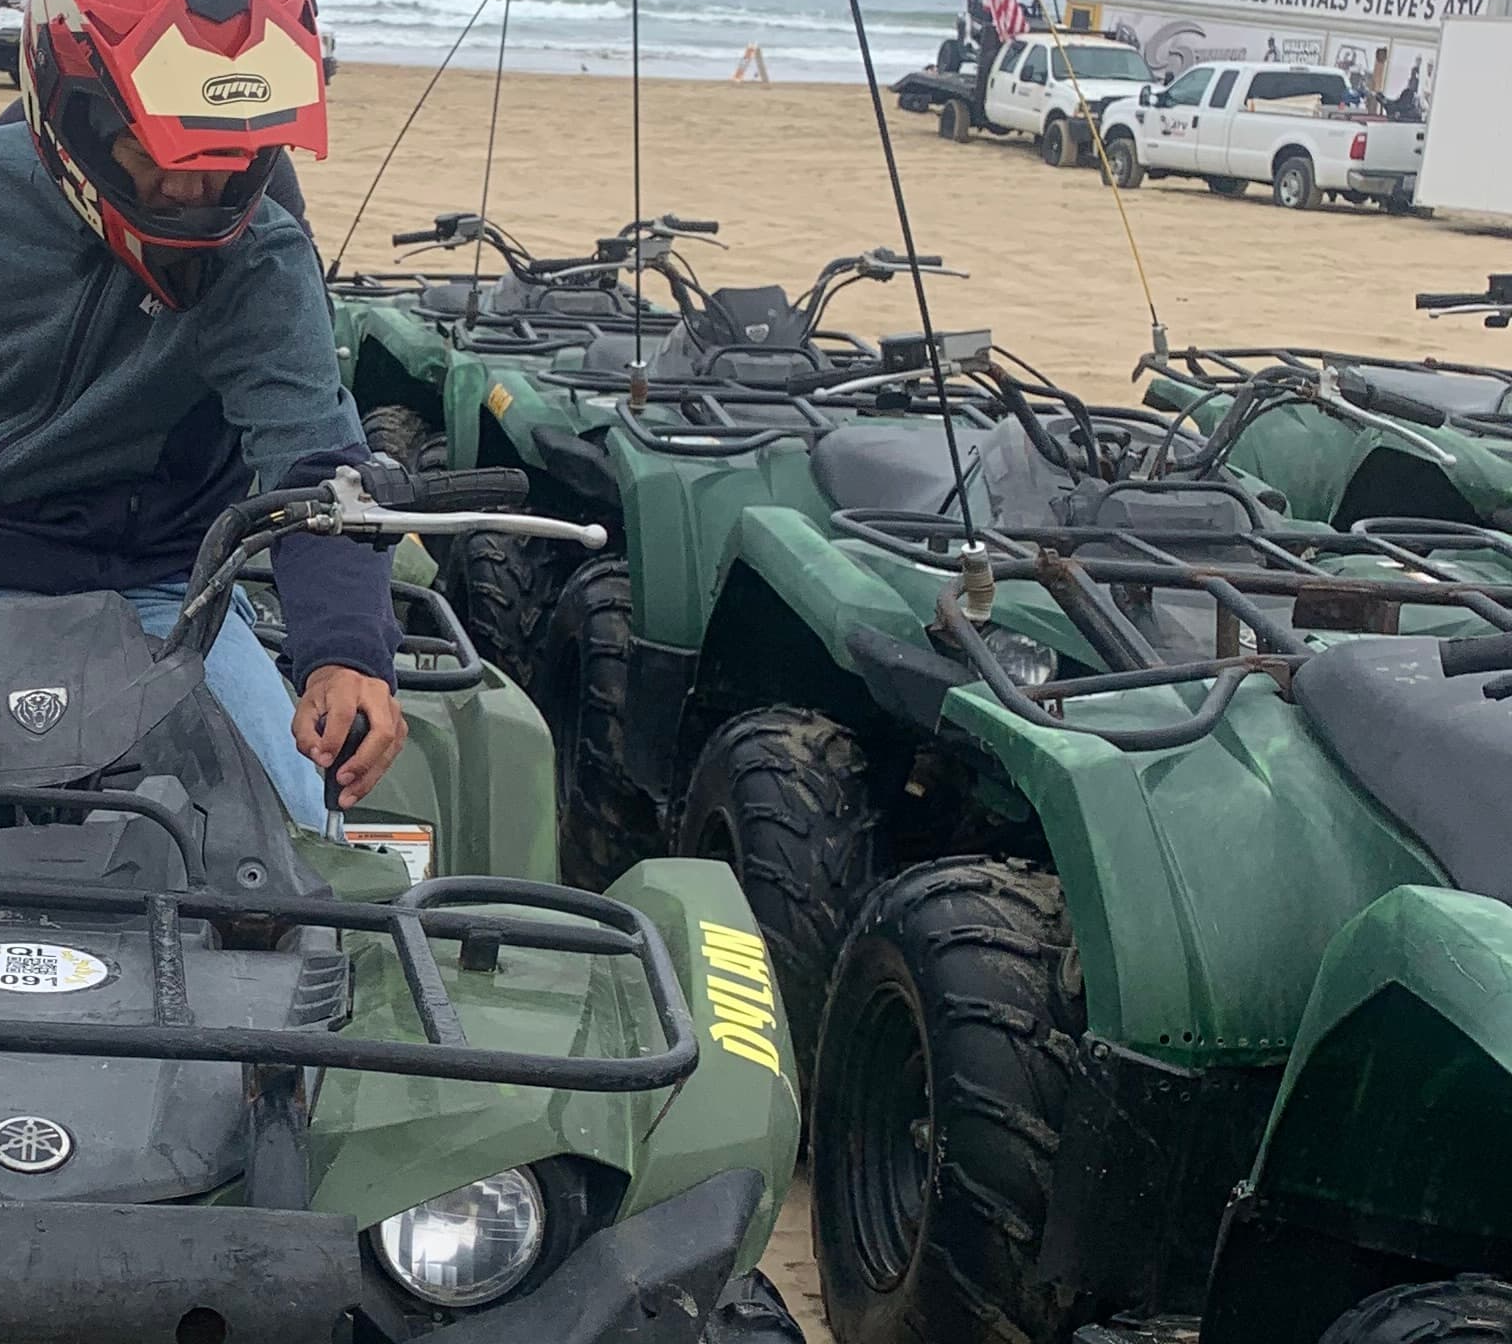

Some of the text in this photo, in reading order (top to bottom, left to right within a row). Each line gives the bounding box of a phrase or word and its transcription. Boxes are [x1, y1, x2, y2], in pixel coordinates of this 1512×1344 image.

[6, 946, 57, 958] QL
[0, 974, 59, 987] 091
[699, 920, 779, 1077] DYLAN
